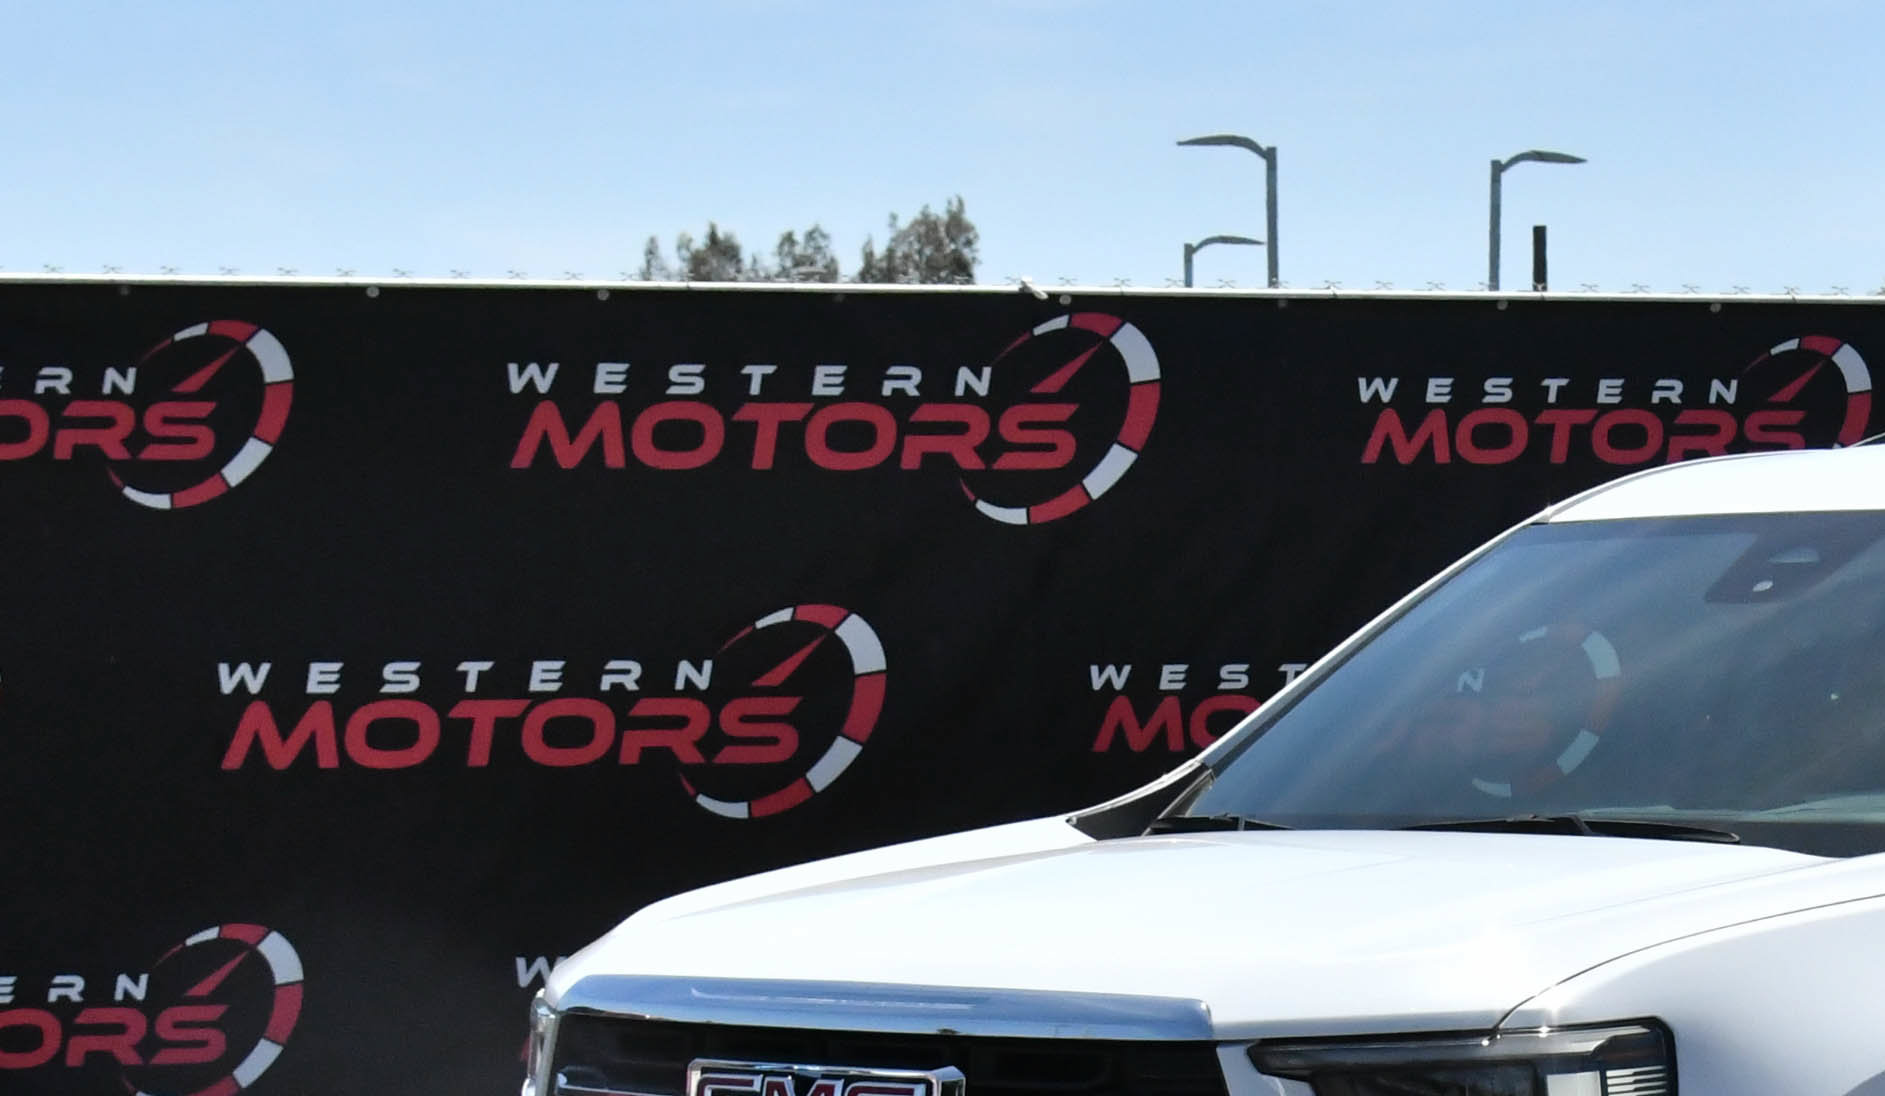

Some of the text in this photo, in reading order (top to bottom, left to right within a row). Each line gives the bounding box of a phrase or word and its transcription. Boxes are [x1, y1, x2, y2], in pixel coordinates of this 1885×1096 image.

[507, 362, 992, 396] WESTERN
[1358, 377, 1738, 404] WESTERN
[510, 400, 1080, 471] MOTORS
[1361, 408, 1806, 464] MOTORS
[217, 660, 713, 695] WESTERN
[220, 696, 804, 770] MOTORS
